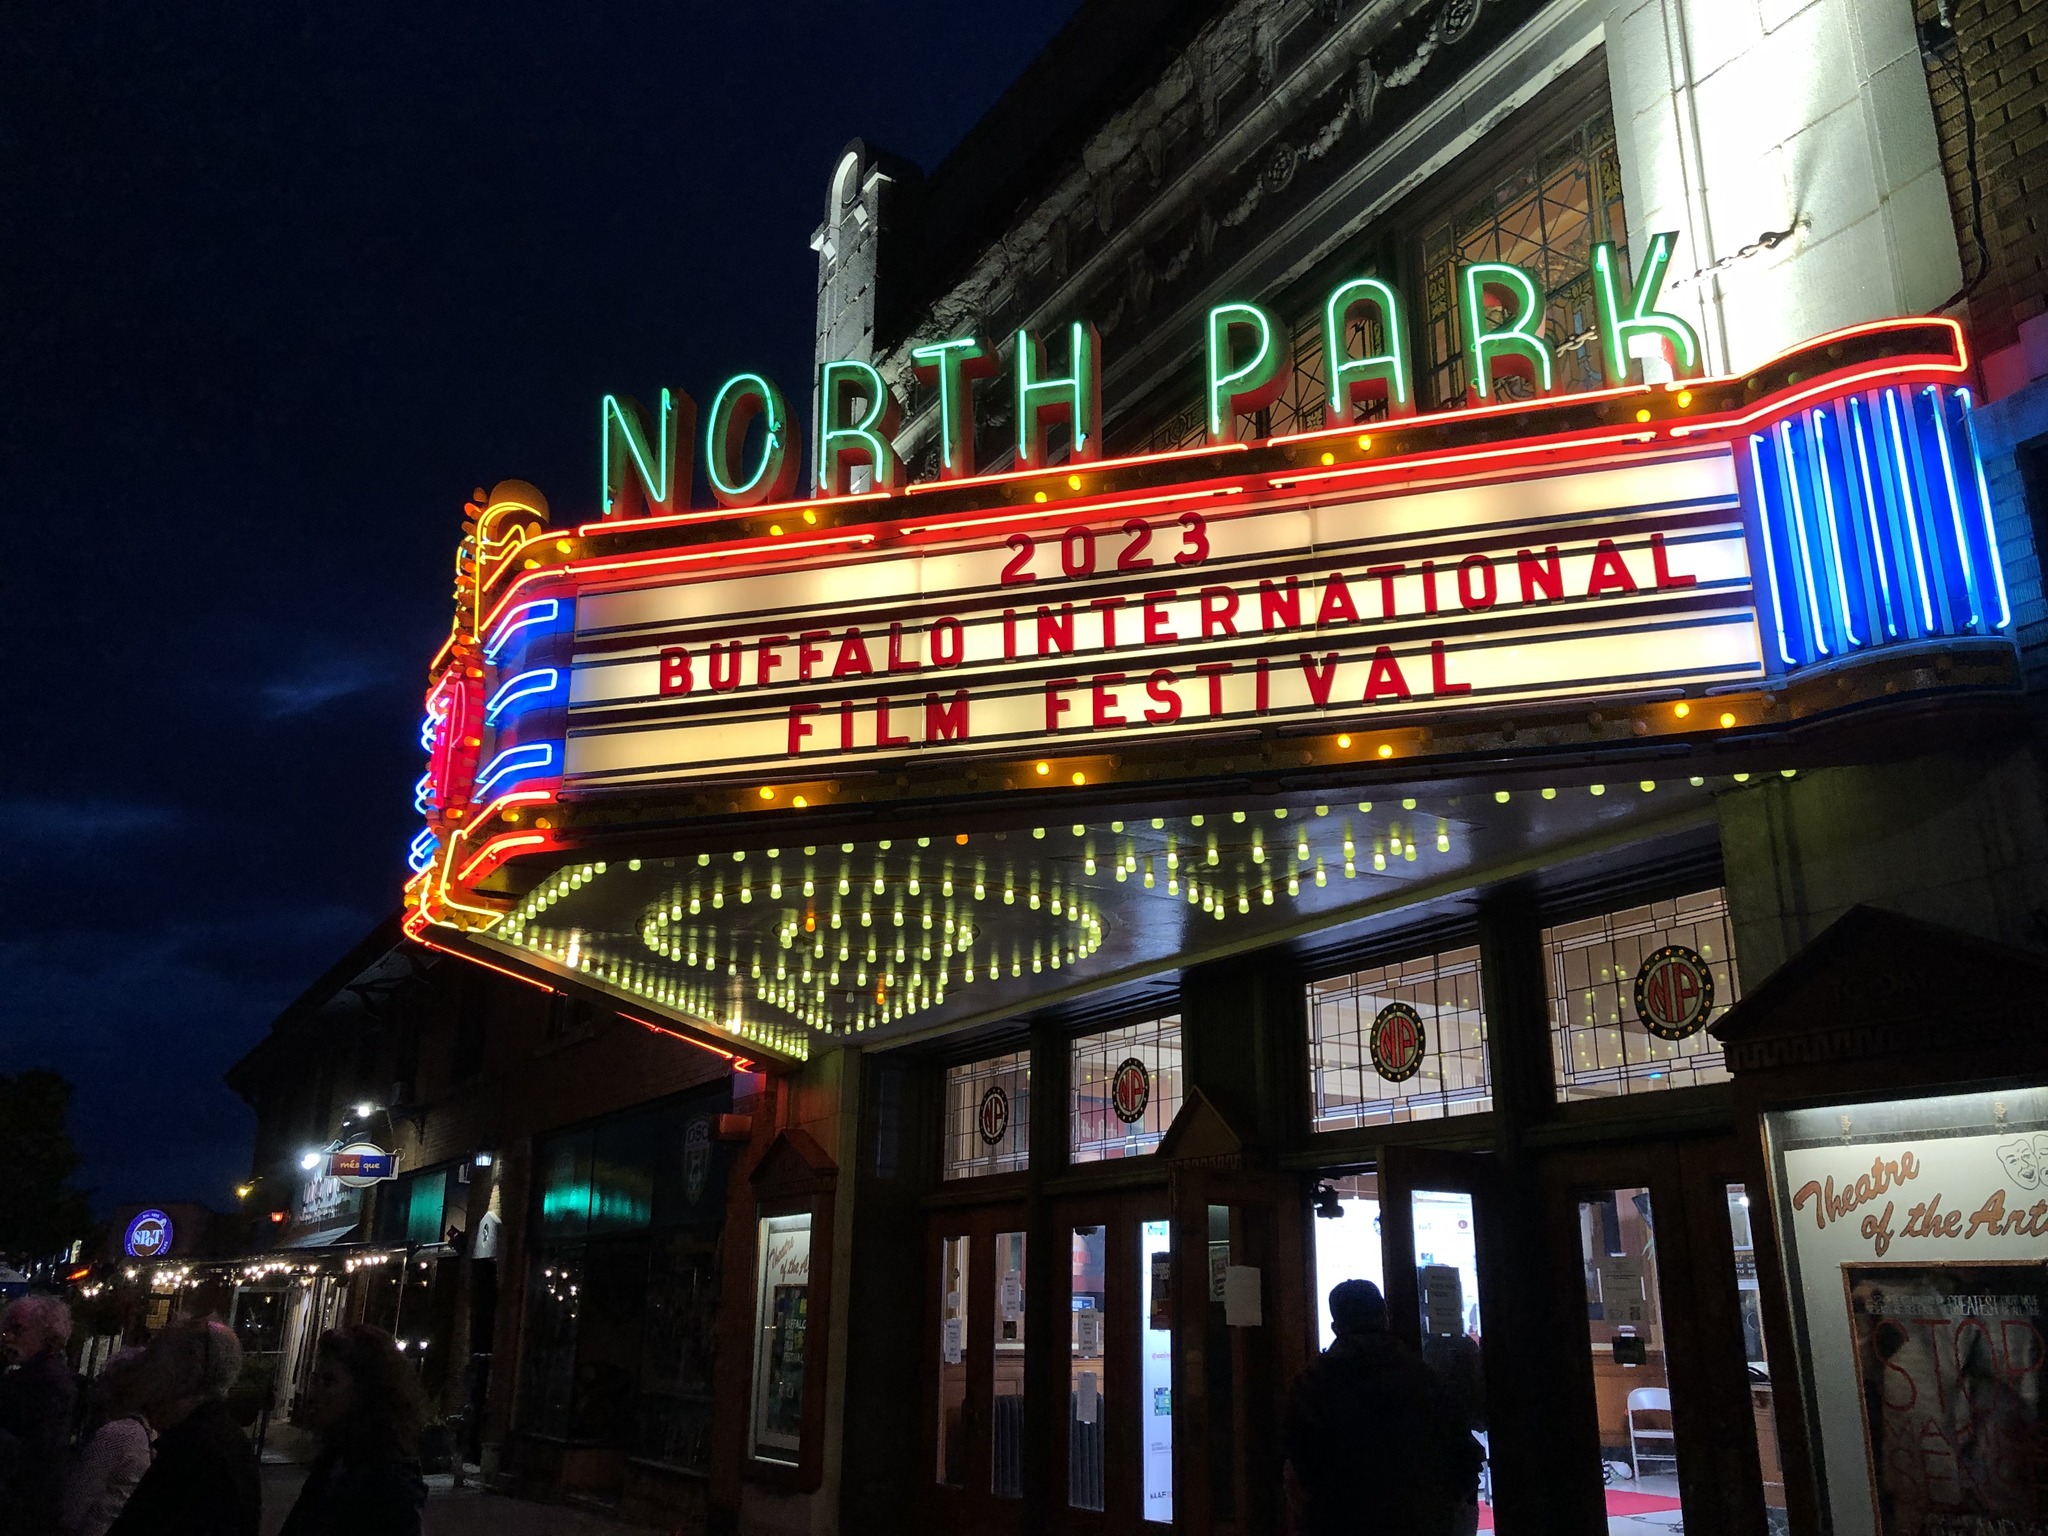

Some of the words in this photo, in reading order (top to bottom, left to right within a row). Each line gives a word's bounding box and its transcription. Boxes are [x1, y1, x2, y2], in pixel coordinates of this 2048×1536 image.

[601, 321, 1101, 521] NORTH
[1205, 231, 1702, 444] PARK
[1001, 512, 1210, 589] 2023
[659, 617, 963, 698] BUFFALO
[1003, 534, 1697, 663] INTERNATIONAL
[788, 690, 969, 758] FILM
[1045, 640, 1472, 735] FESTIVAL
[1648, 963, 1698, 1022] NP
[1380, 1018, 1415, 1068] NP
[1119, 1069, 1143, 1112] NP
[340, 1160, 360, 1169] més
[363, 1162, 380, 1173] que
[1793, 1151, 1920, 1229] Theatre
[1861, 1201, 1895, 1257] of
[1900, 1193, 1963, 1238] the
[1964, 1189, 2048, 1240] Art
[1871, 1317, 2047, 1414] STOP
